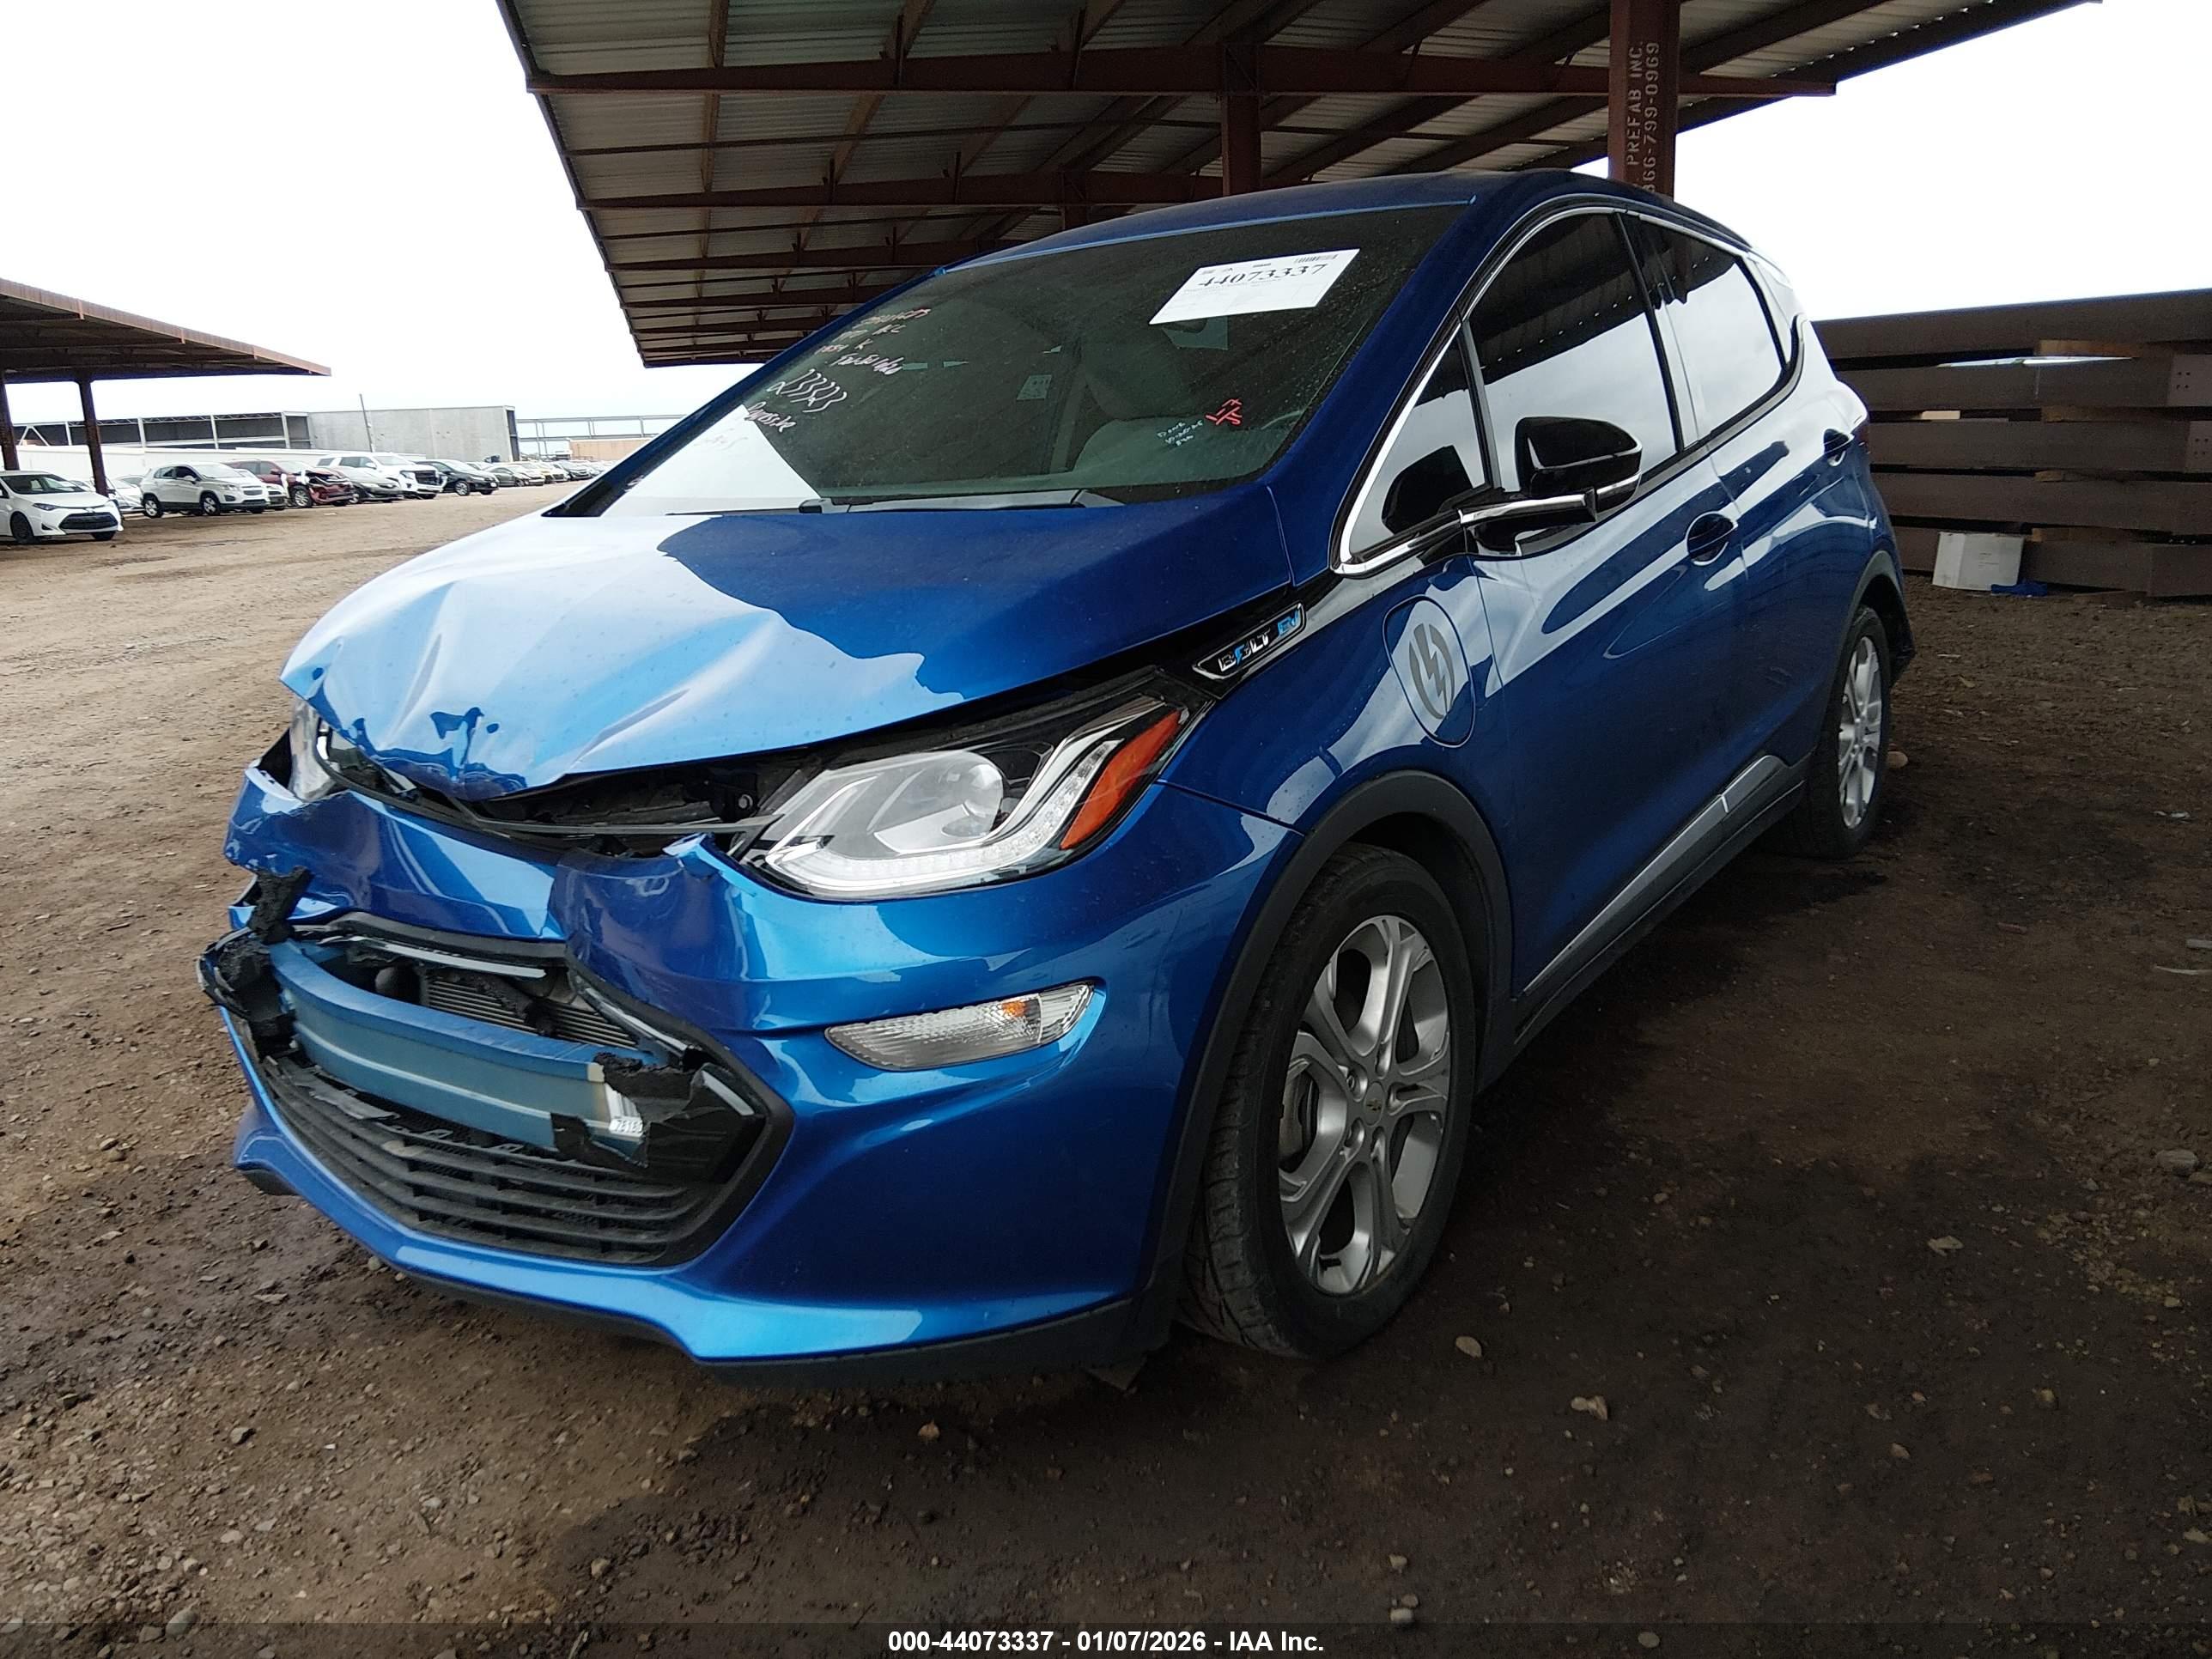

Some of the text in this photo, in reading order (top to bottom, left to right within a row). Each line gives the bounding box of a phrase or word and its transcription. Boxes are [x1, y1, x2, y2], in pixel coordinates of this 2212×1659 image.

[1626, 88, 1642, 166] PREFAB
[1200, 263, 1328, 287] 44073337
[1278, 610, 1299, 637] EV
